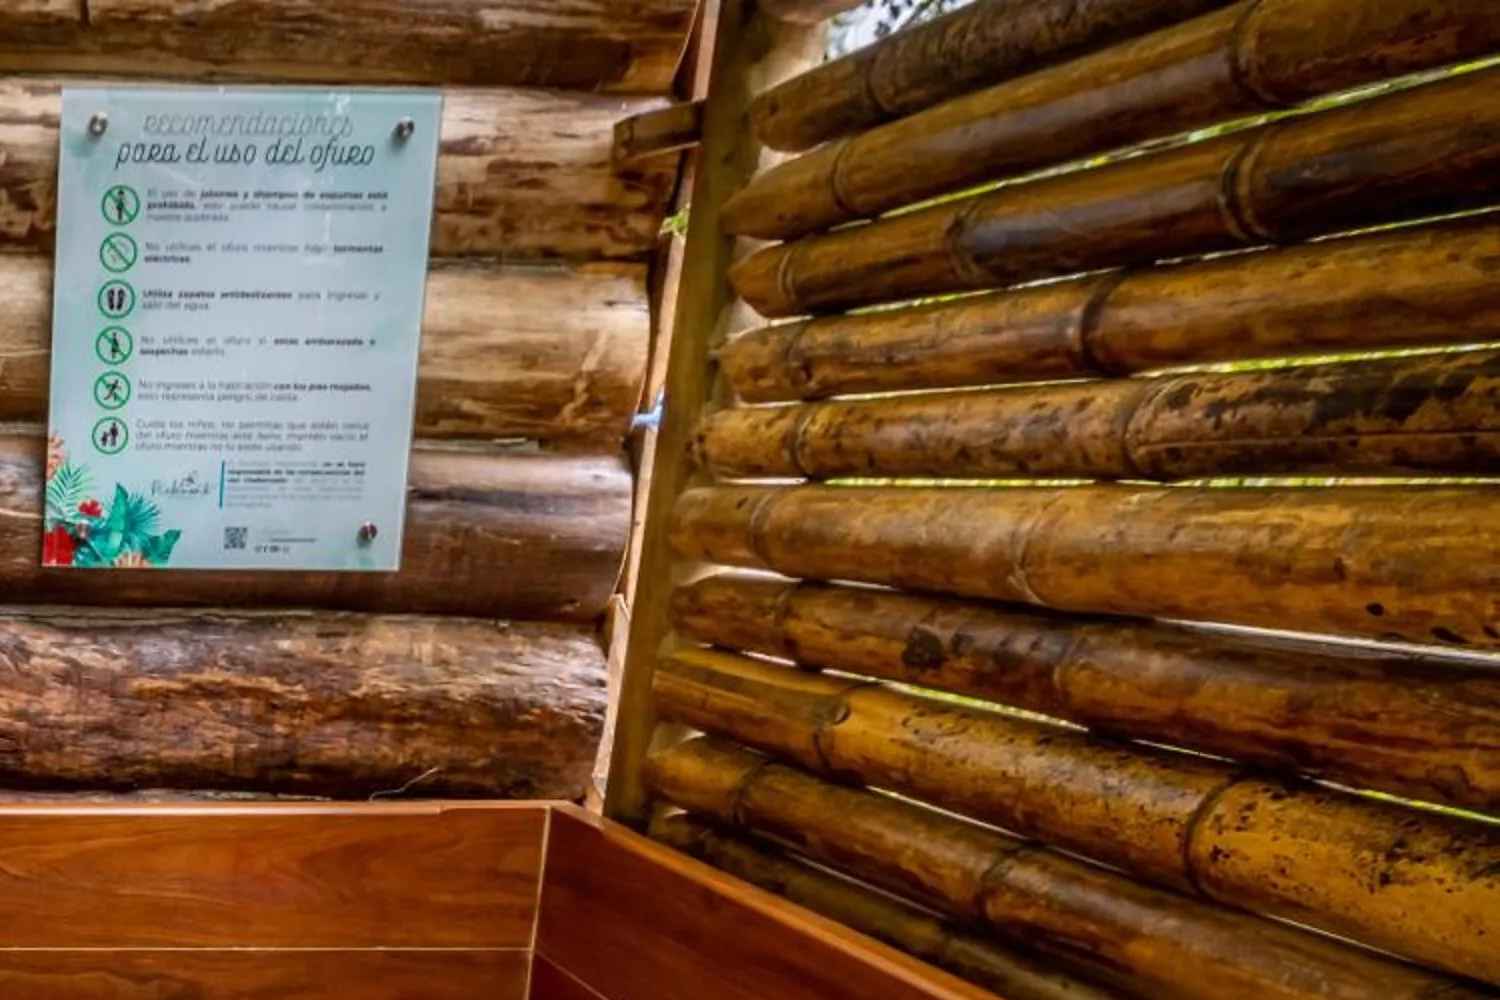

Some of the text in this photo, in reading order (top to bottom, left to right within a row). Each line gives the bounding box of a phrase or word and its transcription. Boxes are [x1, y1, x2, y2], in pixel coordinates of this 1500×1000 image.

[144, 110, 353, 137] recomendaciones
[115, 137, 375, 172] para el uso del ofuro
